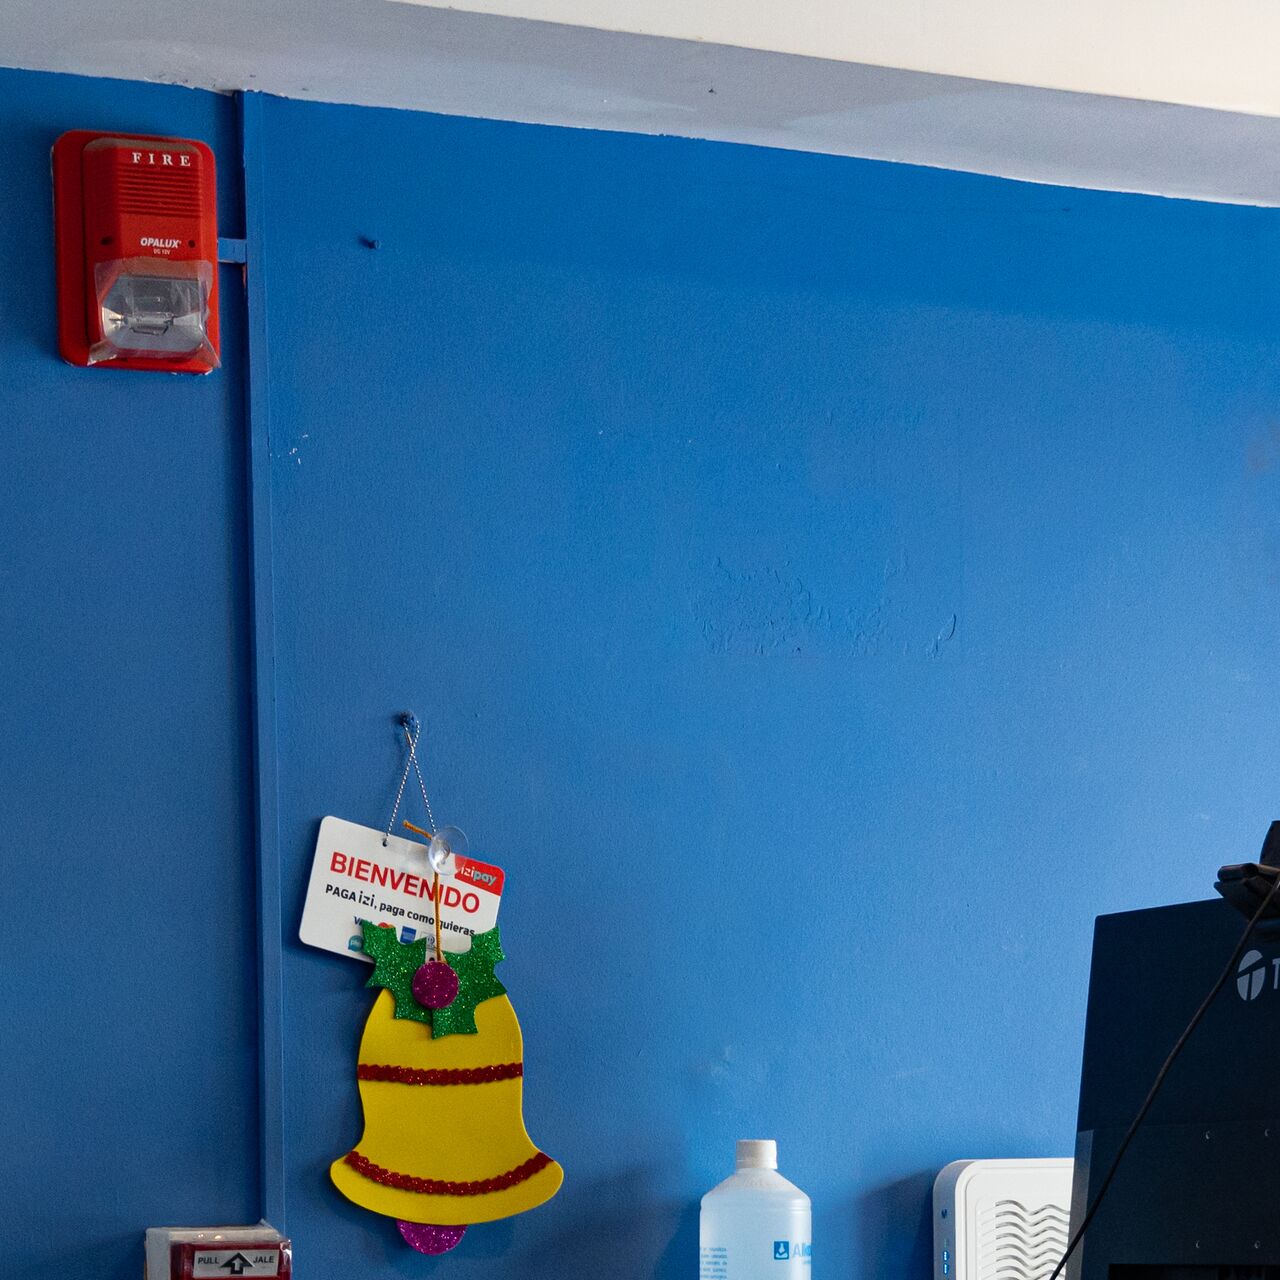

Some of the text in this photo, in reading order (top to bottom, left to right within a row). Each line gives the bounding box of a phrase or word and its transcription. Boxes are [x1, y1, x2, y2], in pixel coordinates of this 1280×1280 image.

[132, 152, 192, 167] FIRE
[140, 237, 181, 249] OPALUX
[330, 851, 480, 914] BIENVENIDO
[460, 865, 497, 886] izipay
[325, 884, 357, 903] PAGA
[379, 903, 405, 917] paga
[407, 911, 435, 925] como
[198, 1256, 219, 1264] PULL
